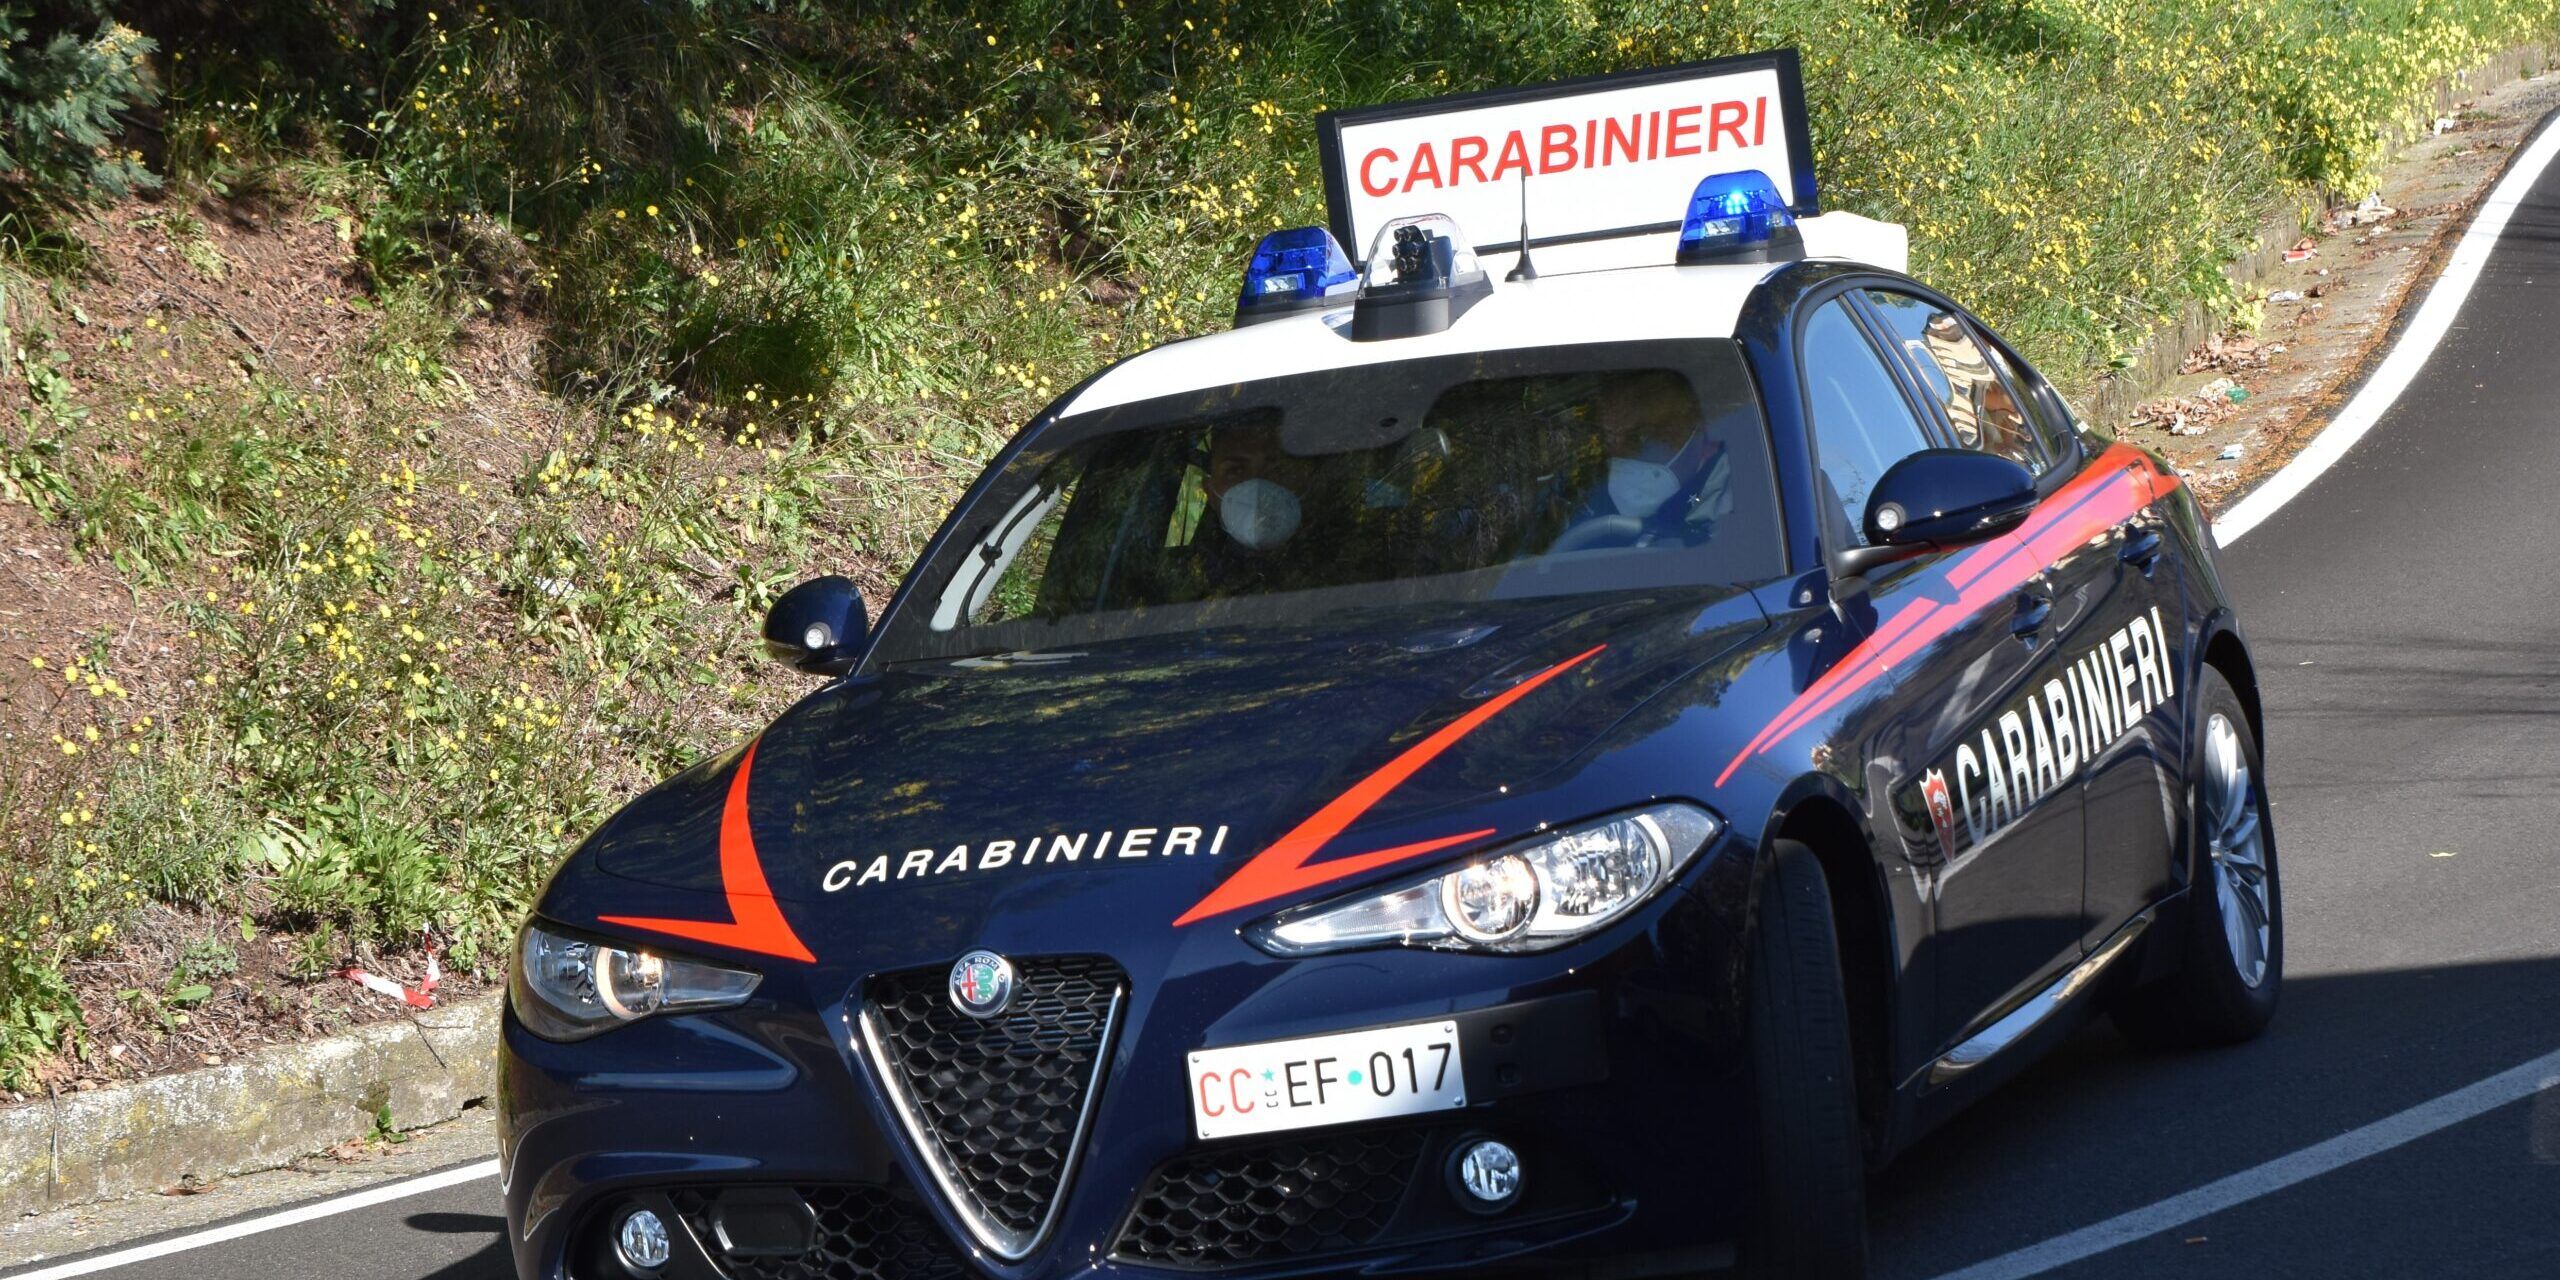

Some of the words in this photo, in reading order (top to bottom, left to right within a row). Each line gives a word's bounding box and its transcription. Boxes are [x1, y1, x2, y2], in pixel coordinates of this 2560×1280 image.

[1359, 97, 1767, 198] CARABINIERI
[1955, 606, 2174, 846] CARABINIERI
[822, 825, 1229, 893] CARABINIERI
[1199, 1068, 1255, 1117] CC
[1284, 1057, 1338, 1108] EF
[1368, 1042, 1453, 1098] 017
